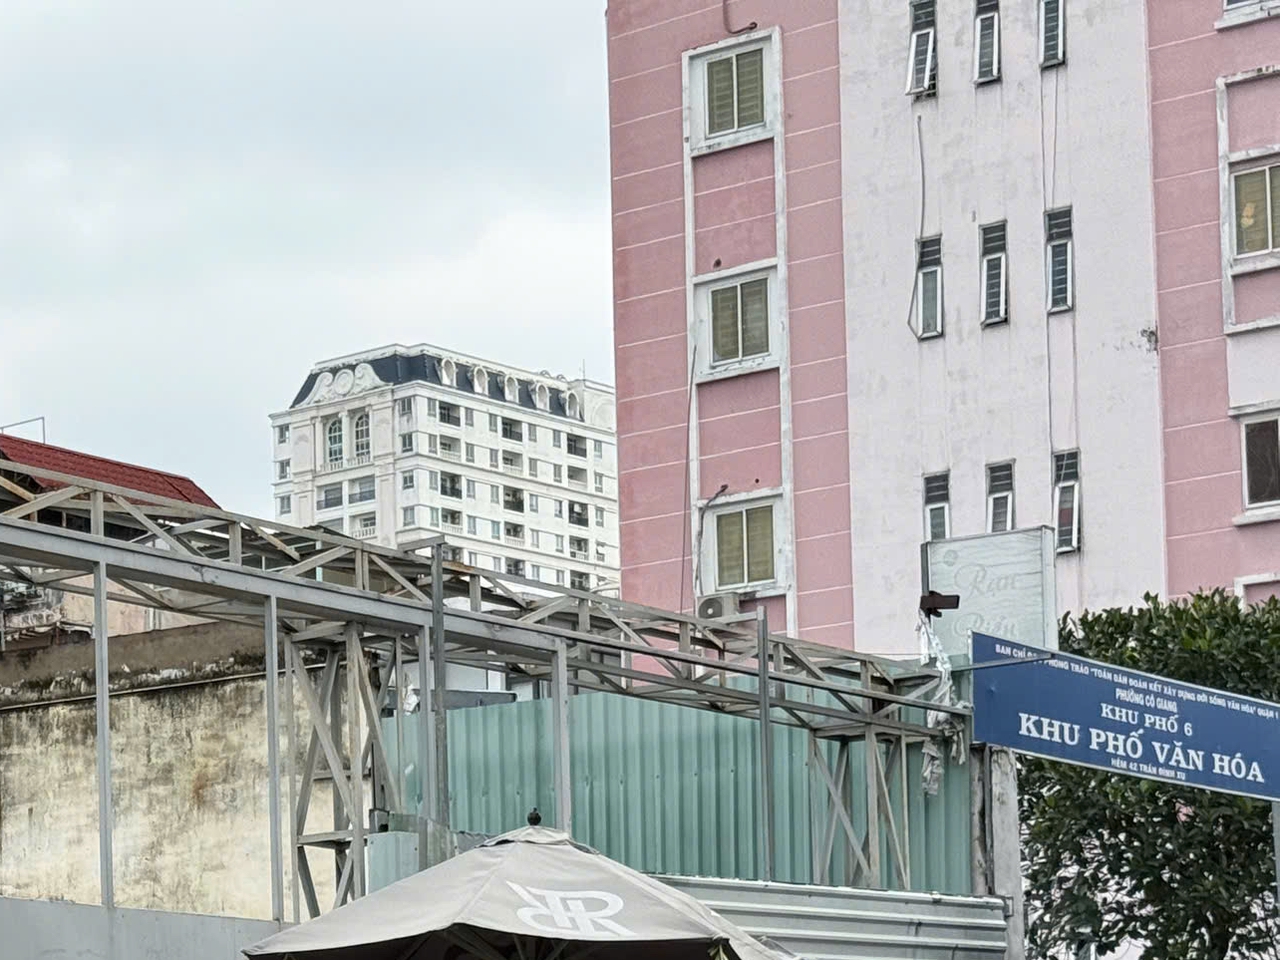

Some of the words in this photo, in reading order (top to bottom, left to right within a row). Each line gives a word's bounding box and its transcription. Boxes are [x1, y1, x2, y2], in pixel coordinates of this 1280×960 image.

[995, 643, 1012, 656] BAN
[1115, 688, 1144, 706] PHƯỜNG
[1145, 693, 1155, 708] CÔ
[1156, 697, 1178, 714] GIANG
[1101, 703, 1139, 725] KHU
[1144, 713, 1179, 733] PHỐ
[1184, 722, 1193, 736] 6
[1018, 712, 1080, 746] KHU
[1088, 728, 1145, 759] PHỐ
[1152, 740, 1205, 772] VĂN
[1212, 752, 1265, 784] HÓA
[1128, 762, 1138, 771] 42
